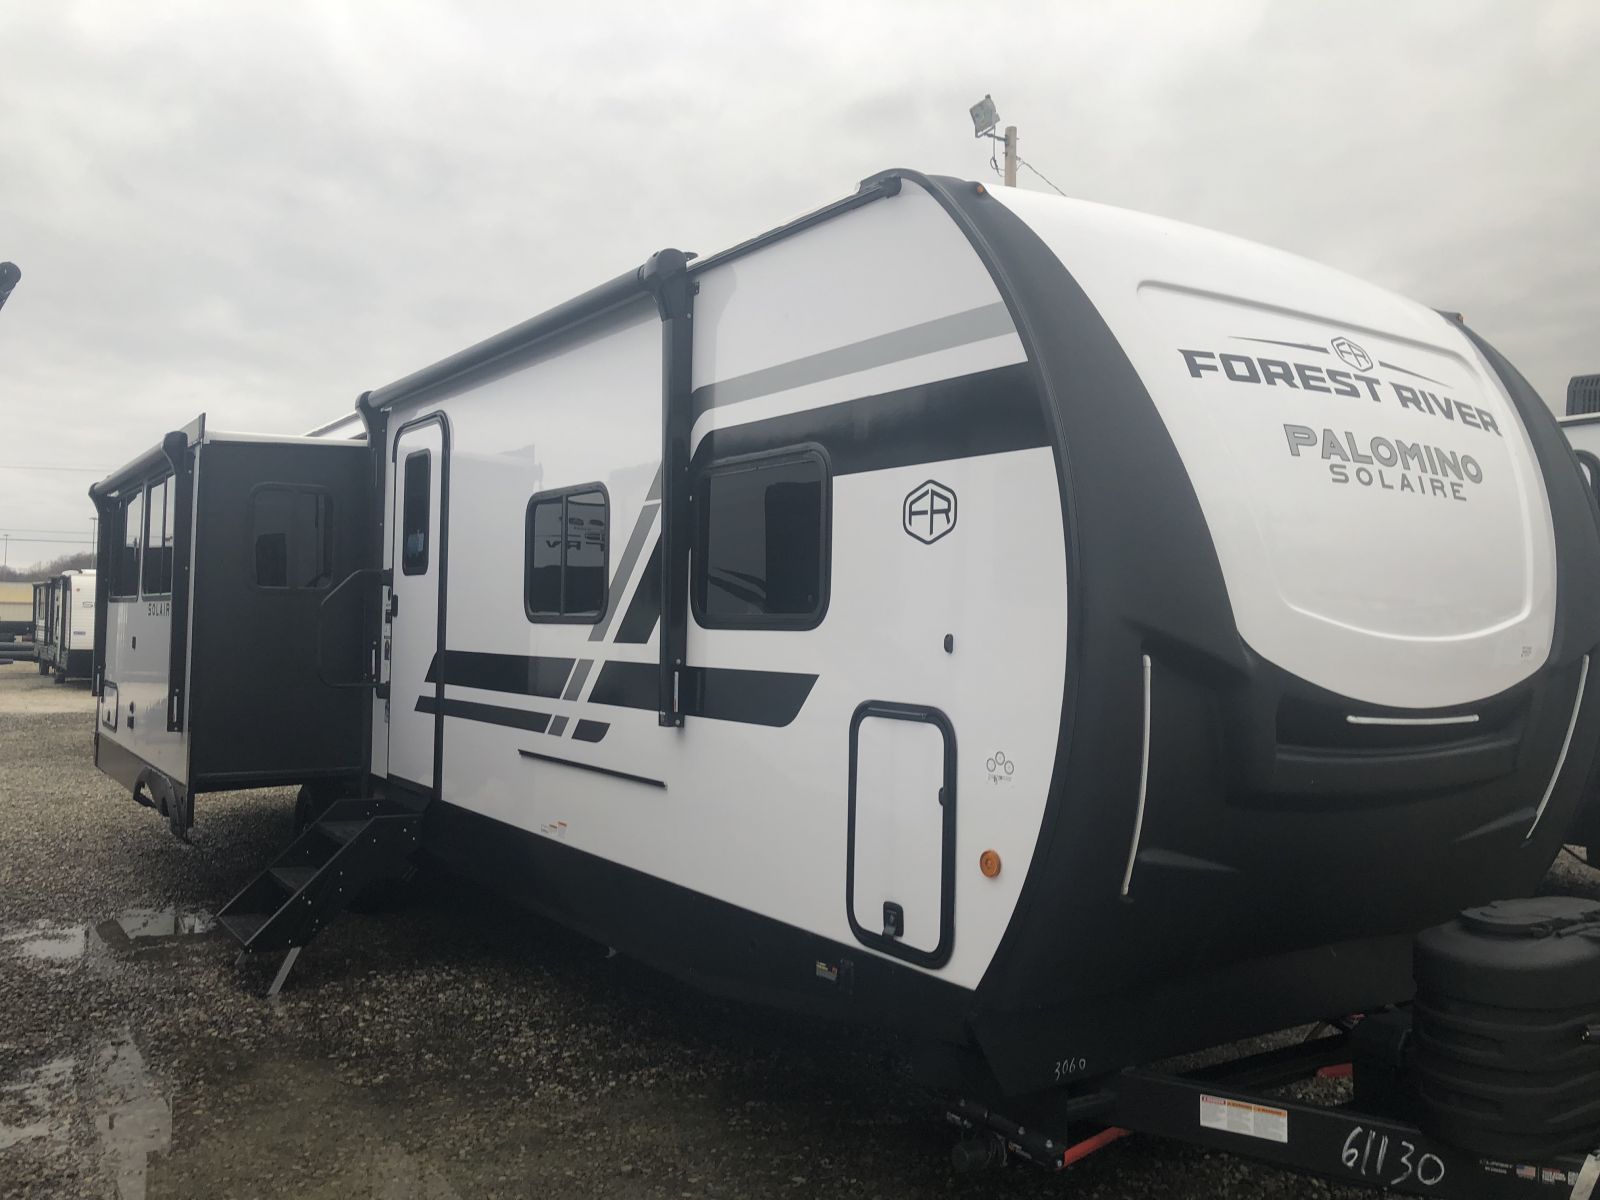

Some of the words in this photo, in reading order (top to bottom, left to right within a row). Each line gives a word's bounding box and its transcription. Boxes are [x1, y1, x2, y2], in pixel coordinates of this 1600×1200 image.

[1178, 348, 1381, 403] FOREST
[1389, 382, 1503, 437] RIVER
[1283, 423, 1483, 484] PALOMINO
[1329, 463, 1467, 502] SOLAIRE
[147, 602, 170, 617] SOLAIR
[1054, 1057, 1086, 1080] 3060
[1341, 1126, 1445, 1186] 61130
